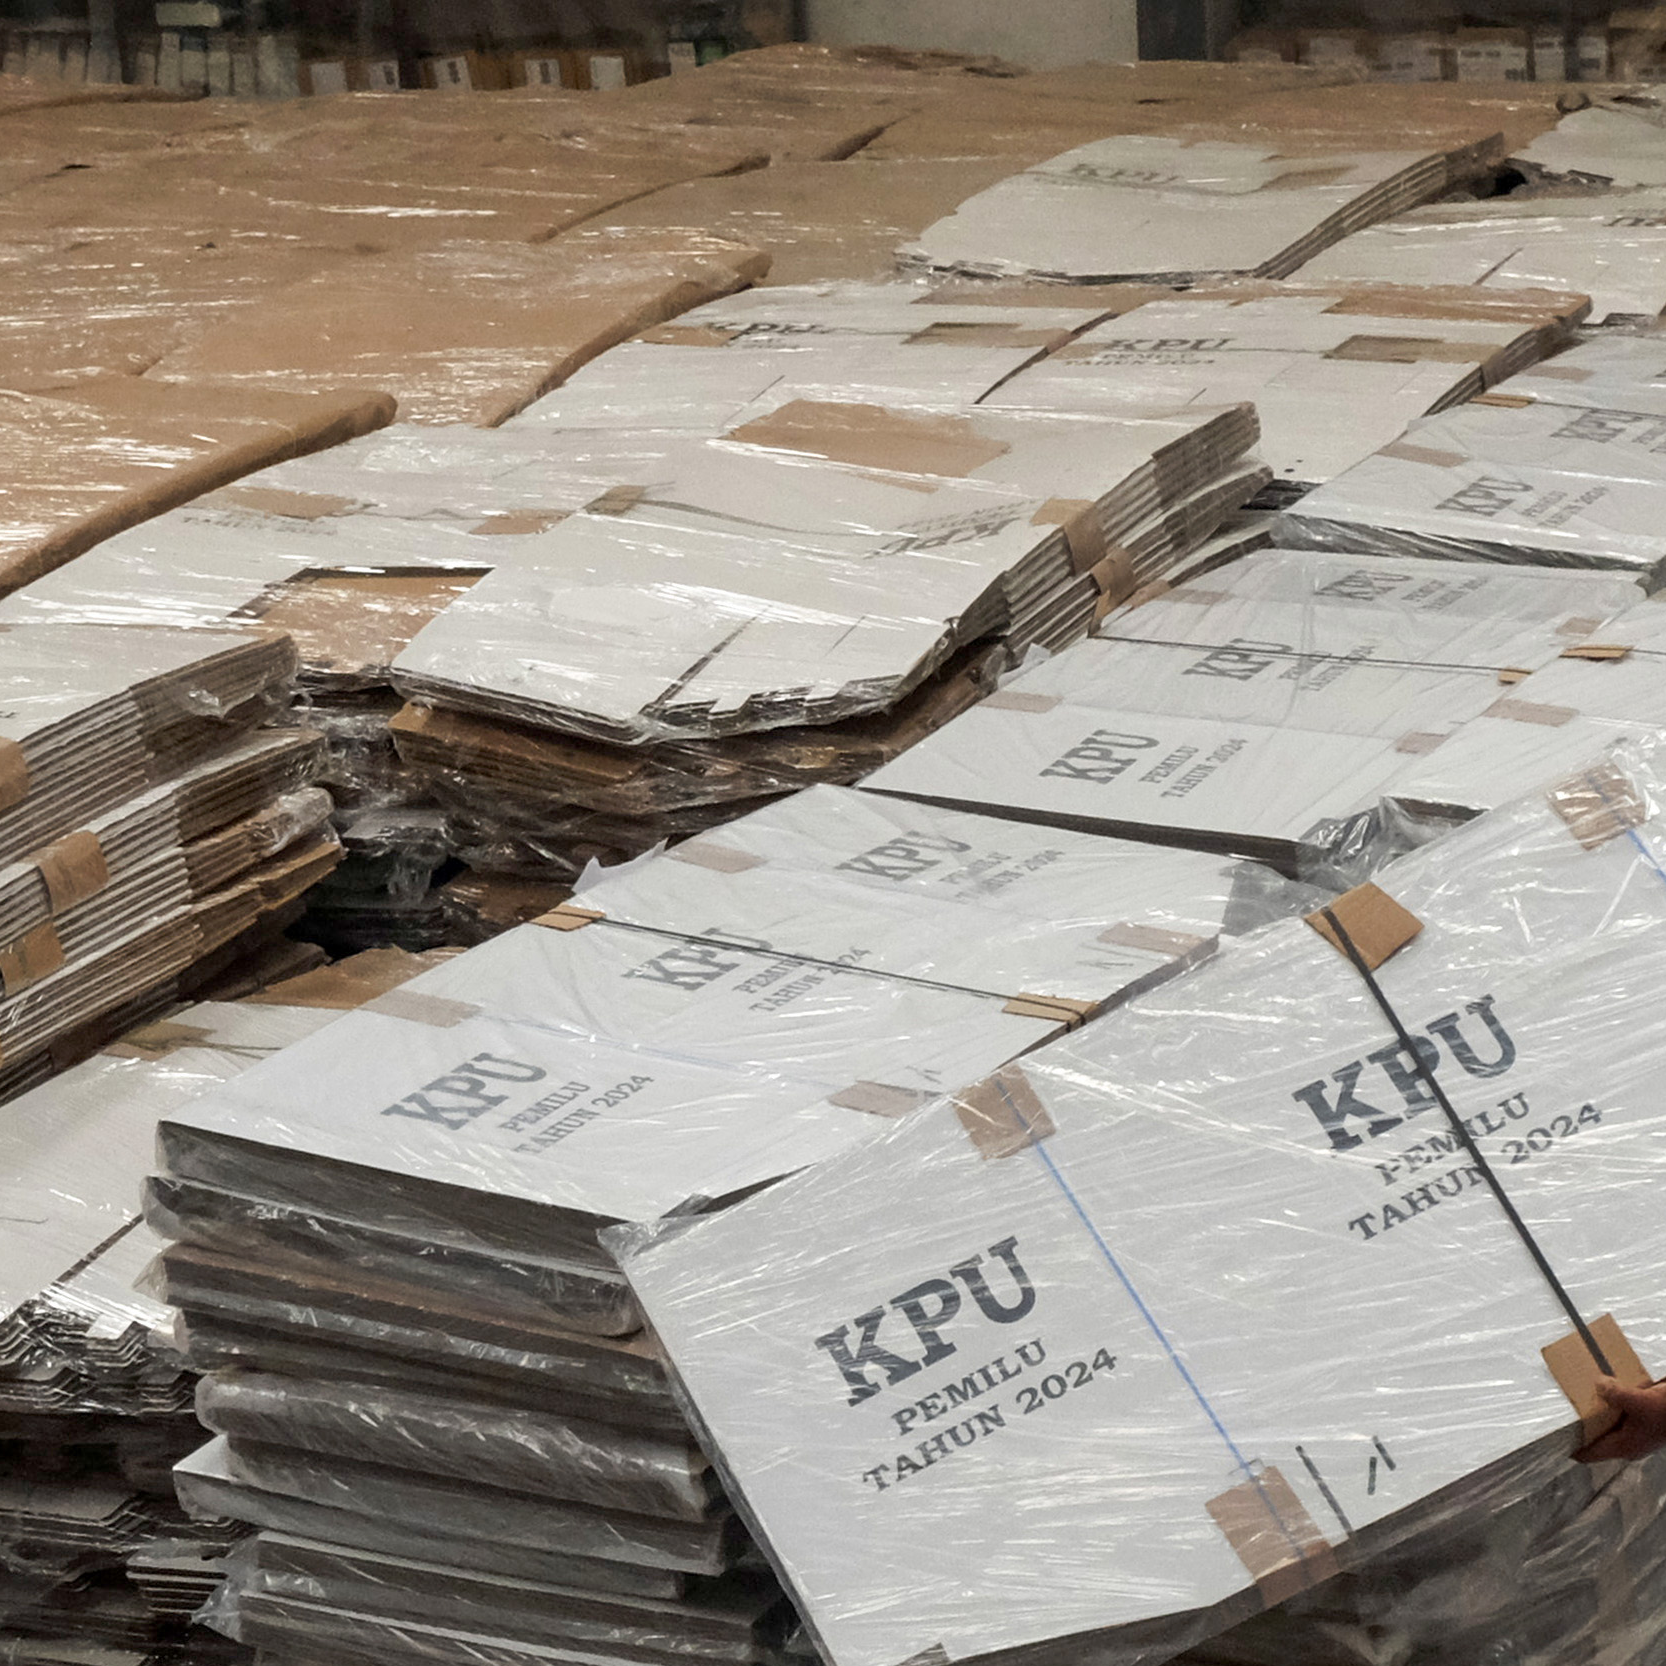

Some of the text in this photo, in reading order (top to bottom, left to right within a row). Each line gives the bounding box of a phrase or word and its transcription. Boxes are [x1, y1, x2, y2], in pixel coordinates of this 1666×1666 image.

[1435, 476, 1534, 517] KPU
[1039, 729, 1160, 784] KPU
[1138, 746, 1199, 783] PEMILU
[834, 830, 972, 881] KPU
[621, 928, 773, 991] KPU
[380, 1052, 547, 1131] KPU
[498, 1081, 591, 1133] PEMILU
[1291, 993, 1516, 1153] KPU
[511, 1074, 655, 1154] TAHUN 2024
[1375, 1092, 1531, 1187] PEMILU
[1500, 1101, 1603, 1165] 2024
[814, 1236, 1038, 1406] KPU
[862, 1346, 1119, 1494] TAHUN 2024
[892, 1337, 1048, 1436] PEMILU
